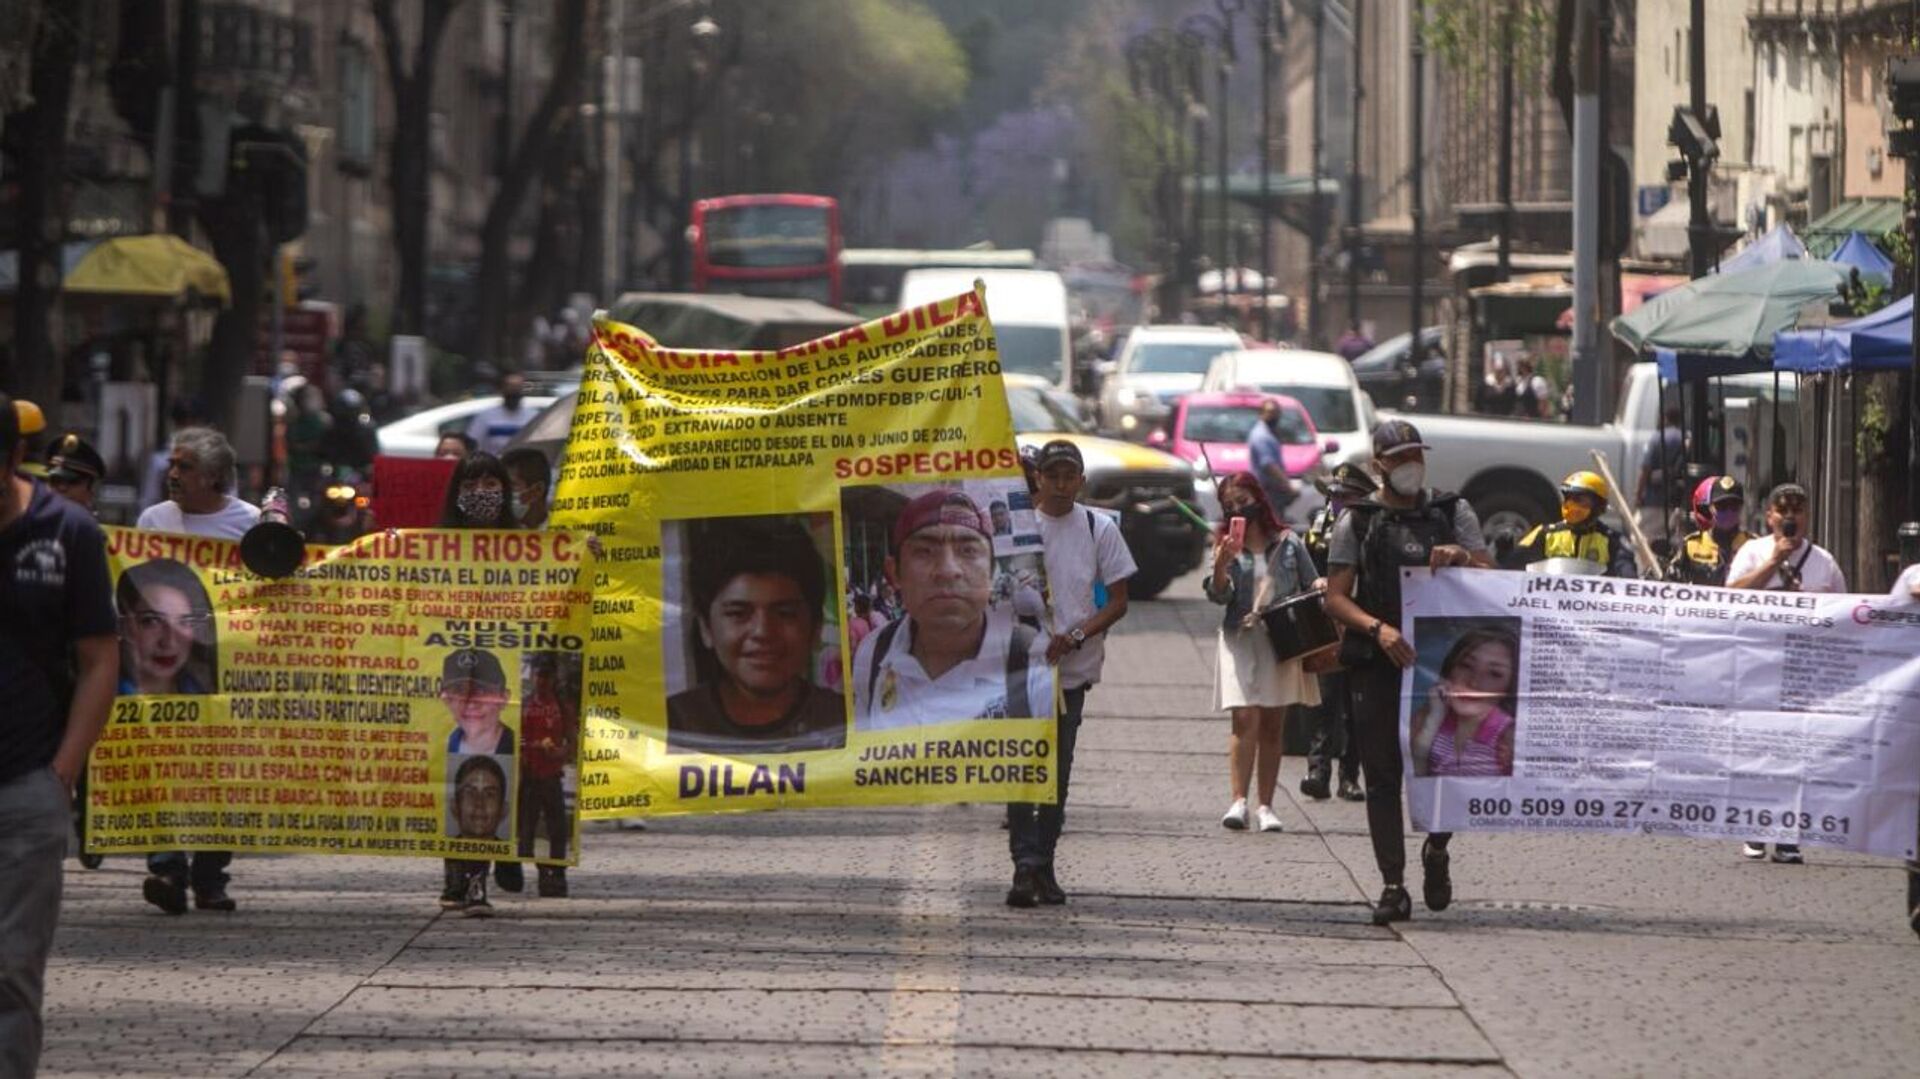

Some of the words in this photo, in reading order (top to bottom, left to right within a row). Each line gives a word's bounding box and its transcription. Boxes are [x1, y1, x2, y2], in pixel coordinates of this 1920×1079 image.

[664, 367, 782, 385] MOVILIZACION
[786, 364, 811, 378] DE
[815, 353, 850, 370] LAS
[726, 386, 772, 398] PARA
[776, 382, 809, 397] DAR
[972, 337, 997, 351] DE
[891, 360, 1001, 383] GUERRERO
[663, 415, 755, 436] EXTRAVIADO
[760, 415, 771, 428] O
[775, 412, 848, 429] AUSENTE
[669, 437, 762, 456] DESAPARECIDO
[765, 435, 807, 450] DESDE
[811, 434, 828, 449] EL
[831, 433, 855, 448] DIA
[857, 433, 867, 448] 9
[869, 431, 909, 446] JUNIO
[912, 429, 930, 443] DE
[931, 427, 967, 442] 2020,
[578, 462, 626, 478] COLONIA
[713, 454, 731, 471] EN
[735, 451, 815, 469] IZTAPALAPA
[576, 496, 590, 509] DE
[592, 493, 631, 508] MEXICO
[107, 529, 242, 570] JUSTICIA
[472, 533, 544, 562] RIOS
[552, 533, 581, 562] C.
[610, 546, 661, 562] REGULAR
[396, 567, 453, 584] HASTA
[457, 568, 479, 585] EL
[483, 569, 511, 585] DIA
[518, 569, 541, 585] DE
[545, 568, 582, 586] HOY
[219, 588, 232, 601] A
[253, 583, 313, 599] MESES
[317, 583, 332, 597] Y
[335, 585, 356, 599] 16
[360, 587, 403, 600] DIAS
[405, 588, 446, 602] ERICK
[448, 588, 527, 604] HERNANDEZ
[531, 591, 592, 606] CAMACHO
[1527, 576, 1616, 596] ¡HASTA
[1625, 582, 1817, 610] ENCONTRARLE!
[266, 601, 391, 618] AUTORIDADES
[422, 604, 463, 618] OMAR
[466, 605, 522, 619] SANTOS
[526, 605, 571, 620] LOERA
[593, 599, 635, 615] EDIANA
[1507, 596, 1553, 609] JAEL
[1557, 598, 1669, 617] MONSERRAT
[1674, 605, 1729, 620] URIBE
[1734, 610, 1835, 628] PALMEROS
[227, 618, 255, 632] NO
[259, 619, 298, 634] HAN
[303, 621, 365, 635] HECHO
[371, 622, 420, 638] NADA
[444, 620, 549, 634] MULTI
[256, 633, 315, 650] HASTA
[321, 635, 357, 650] HOY
[424, 633, 584, 651] ASESINO
[233, 652, 281, 667] PARA
[286, 653, 420, 671] ENCONTRARLO
[222, 670, 272, 692] CUANDO
[274, 671, 291, 692] ES
[292, 672, 318, 692] MUY
[321, 673, 356, 693] FACIL
[356, 674, 443, 698] IDENTIFICARLO
[588, 681, 618, 697] OVAL
[150, 700, 200, 722] 2020
[230, 698, 254, 720] POR
[257, 700, 281, 720] SUS
[282, 694, 322, 721] SEÑAS
[325, 701, 411, 725] PARTICULARES
[95, 747, 114, 761] EN
[116, 747, 134, 760] LA
[136, 744, 188, 759] PIERNA
[190, 743, 264, 758] IZQUIERDA
[269, 744, 297, 758] USA
[300, 745, 356, 760] BASTON
[361, 748, 371, 760] O
[374, 748, 429, 762] MULETA
[858, 741, 917, 762] JUAN
[923, 738, 1050, 760] FRANCISCO
[91, 765, 130, 783] TIENE
[132, 764, 150, 781] UN
[154, 762, 215, 780] TATUAJE
[217, 762, 237, 779] EN
[240, 763, 259, 780] LA
[261, 764, 320, 781] ESPALDA
[323, 766, 352, 781] CON
[356, 767, 373, 782] LA
[376, 768, 430, 785] IMAGEN
[678, 761, 807, 799] DILAN
[854, 764, 958, 787] SANCHES
[964, 762, 1049, 785] FLORES
[92, 789, 110, 806] DE
[112, 788, 129, 804] LA
[130, 785, 168, 804] SANTA
[171, 786, 223, 802] MUERTE
[226, 787, 252, 804] QUE
[255, 788, 271, 803] LE
[274, 788, 322, 805] ABARCA
[326, 790, 360, 807] TODA
[362, 791, 379, 807] LA
[381, 791, 437, 809] ESPALDA
[156, 812, 219, 829] RECLUSORIO
[220, 812, 263, 829] ORIENTE
[404, 817, 438, 834] PRESO
[1468, 798, 1512, 816] 800
[1520, 798, 1565, 816] 509
[1574, 798, 1605, 817] 09
[1613, 801, 1645, 819] 27
[1669, 803, 1717, 823] 800
[1725, 806, 1773, 827] 216
[1781, 811, 1812, 830] 03
[1821, 815, 1850, 834] 61
[91, 835, 150, 847] PURGABA
[151, 834, 177, 846] UNA
[179, 833, 237, 846] CONDENA
[239, 834, 258, 847] DE
[285, 833, 318, 847] AÑOS
[320, 837, 345, 849] POR
[349, 837, 364, 849] LA
[366, 838, 418, 850] MUERTE
[419, 840, 437, 852] DE
[449, 841, 511, 856] PERSONAS
